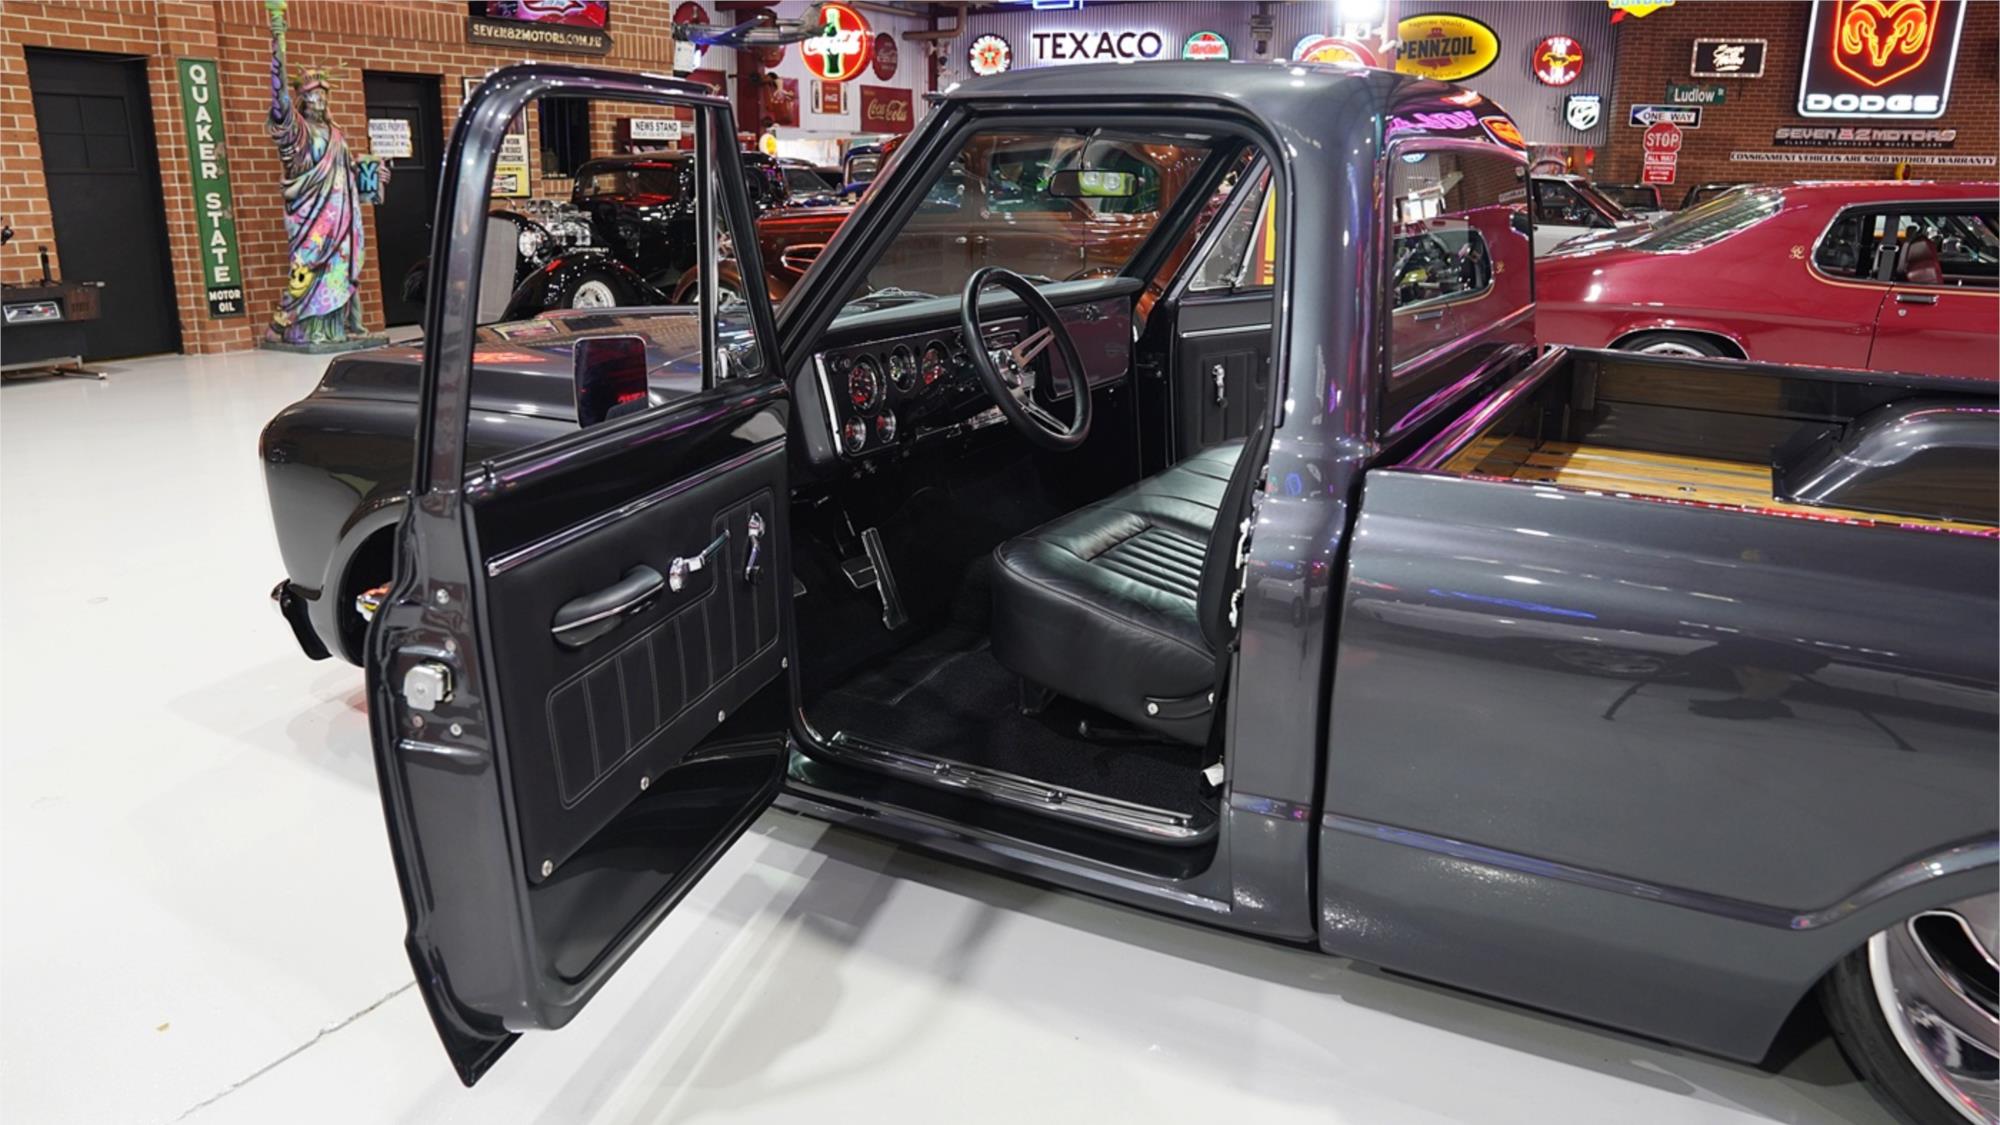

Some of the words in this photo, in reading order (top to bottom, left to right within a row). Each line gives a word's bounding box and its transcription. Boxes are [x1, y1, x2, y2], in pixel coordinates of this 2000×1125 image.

[1033, 32, 1162, 59] TEXACO
[1396, 36, 1476, 60] PENNZOIL
[1674, 88, 1715, 102] Ludlow
[1806, 94, 1939, 111] DODGE
[1643, 111, 1665, 120] ONE
[1670, 112, 1693, 120] WAY
[635, 121, 654, 131] NEWS
[656, 121, 678, 132] STAND
[1646, 131, 1680, 147] STOP
[1731, 152, 1797, 161] CONSIGNMENT
[1798, 154, 1842, 162] VEHICLES
[1864, 155, 1889, 163] SOLD
[1937, 156, 1994, 164] WARRANTY
[189, 64, 218, 179] QUAKER
[205, 192, 231, 283] STATE
[209, 289, 241, 301] MOTOR
[218, 302, 235, 312] OIL
